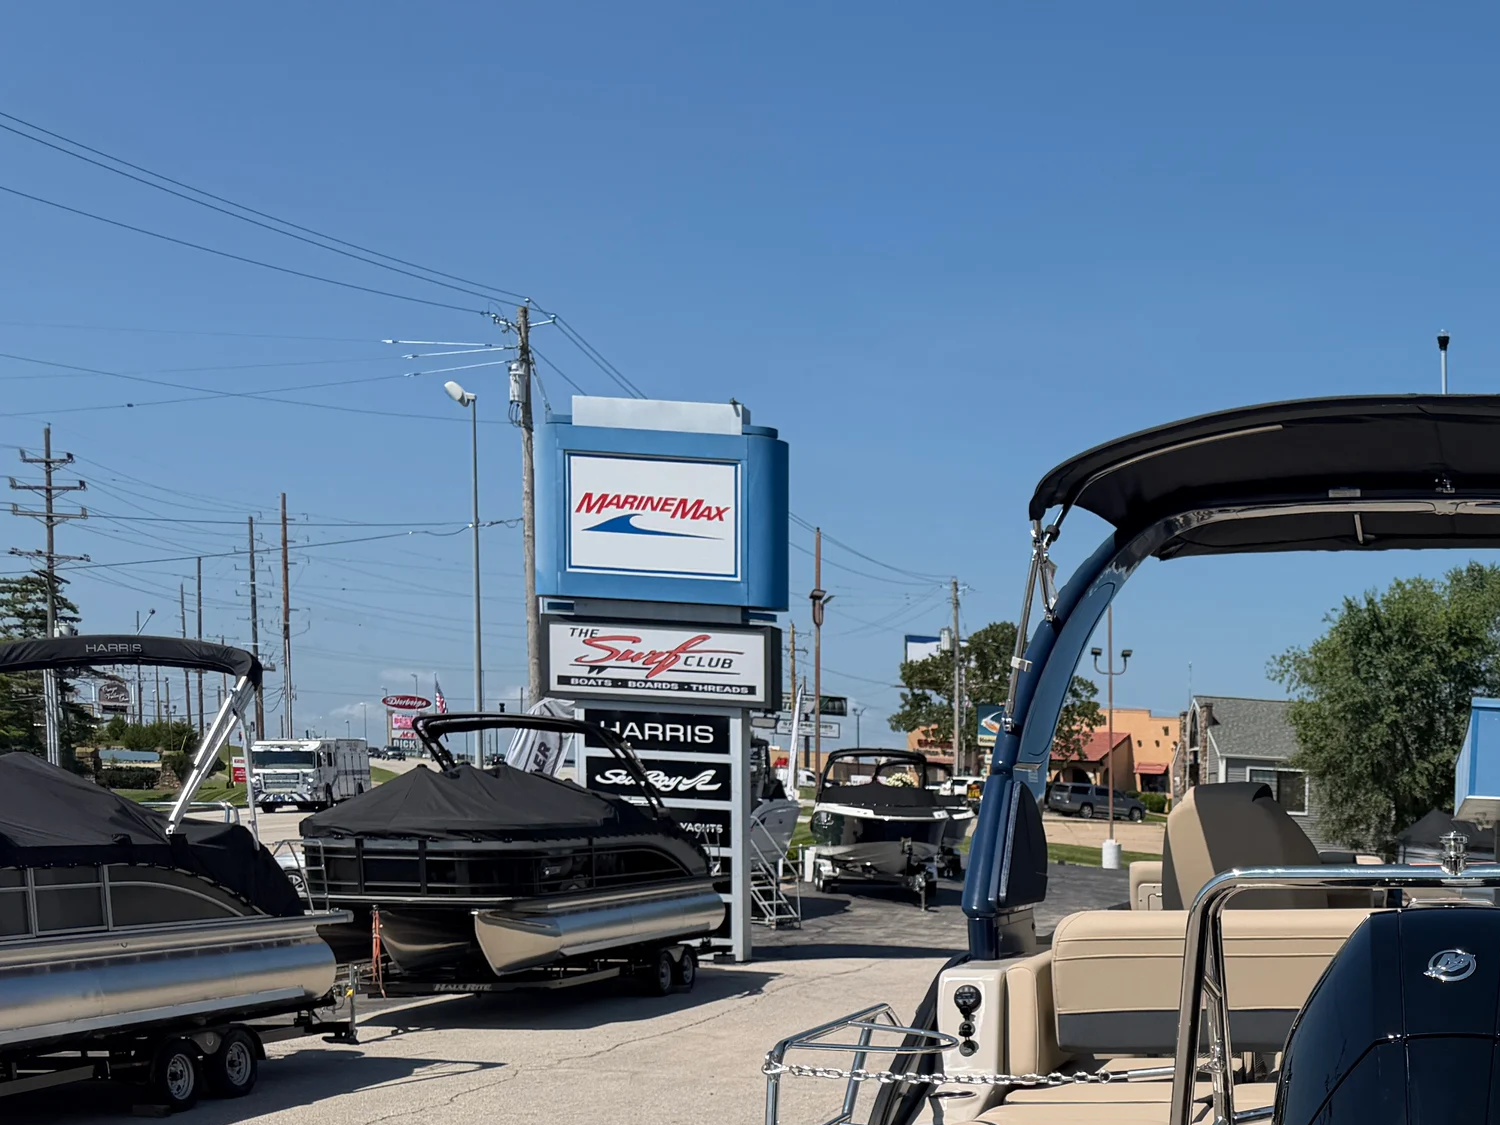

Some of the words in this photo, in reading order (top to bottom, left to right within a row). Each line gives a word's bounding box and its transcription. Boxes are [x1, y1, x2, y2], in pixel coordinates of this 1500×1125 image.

[575, 492, 730, 522] MARINEMAX
[569, 627, 599, 639] THE
[85, 643, 143, 653] HARRIS
[574, 634, 744, 679] Surf
[684, 656, 733, 669] CLUB
[570, 677, 612, 687] BOATS
[628, 680, 679, 690] BOARDS
[690, 684, 749, 694] THREADS
